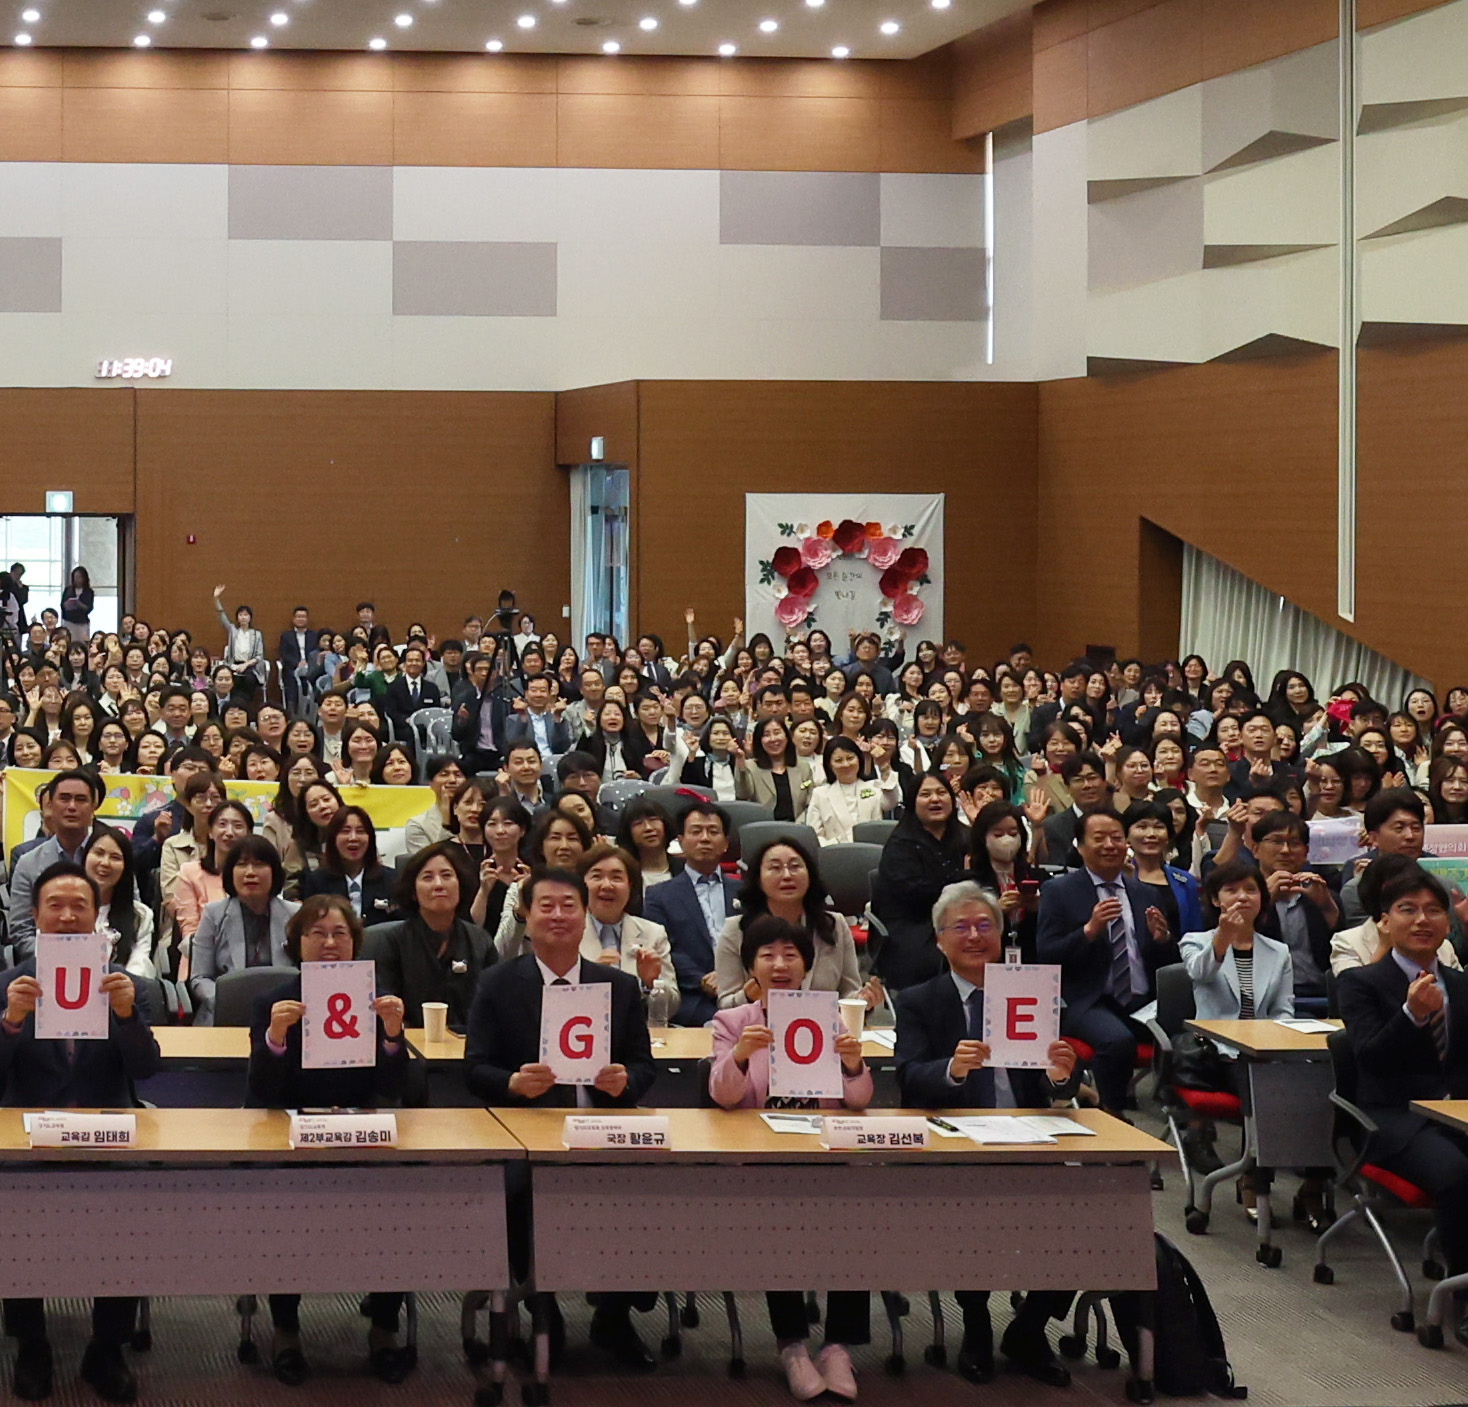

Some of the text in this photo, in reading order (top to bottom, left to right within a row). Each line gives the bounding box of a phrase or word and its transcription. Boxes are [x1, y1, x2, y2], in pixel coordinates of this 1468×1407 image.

[100, 358, 172, 378] 11:39:04
[55, 966, 92, 1010] U
[323, 992, 361, 1040] &
[559, 1015, 595, 1060] G
[784, 1018, 824, 1065] O
[1006, 997, 1039, 1041] E
[60, 1130, 130, 1143] 교육감 임태희
[300, 1130, 391, 1143] 제2부교육감 김송미
[606, 1132, 665, 1145] 국장 황윤규
[857, 1132, 924, 1145] 교육장 김선복
